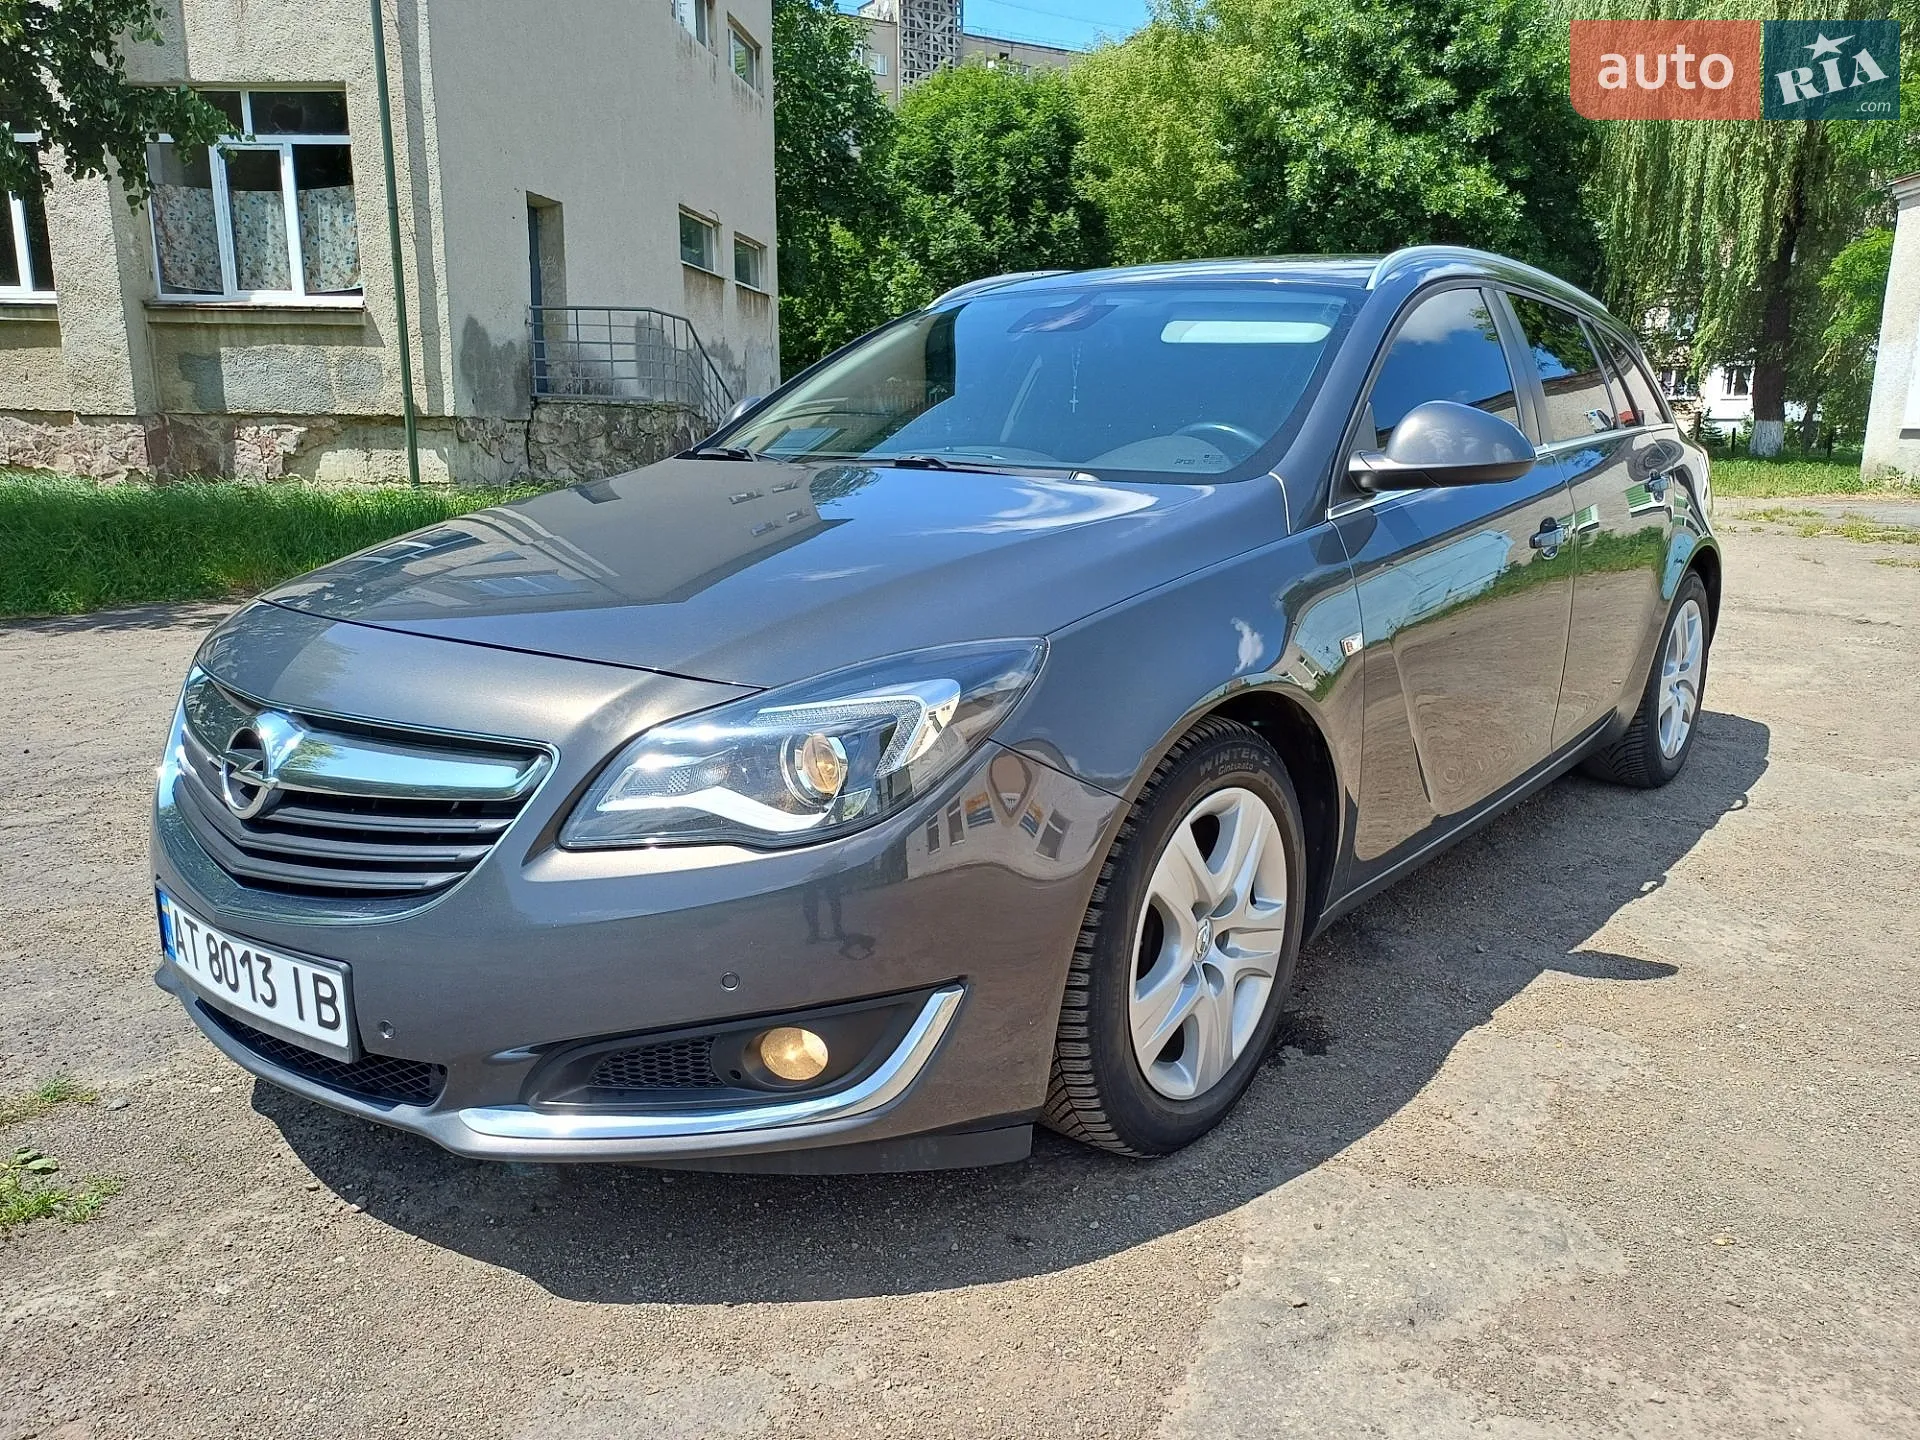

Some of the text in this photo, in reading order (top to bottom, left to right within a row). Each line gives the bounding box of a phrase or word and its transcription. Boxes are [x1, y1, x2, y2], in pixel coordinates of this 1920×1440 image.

[174, 909, 341, 1031] AT 8013 IB
